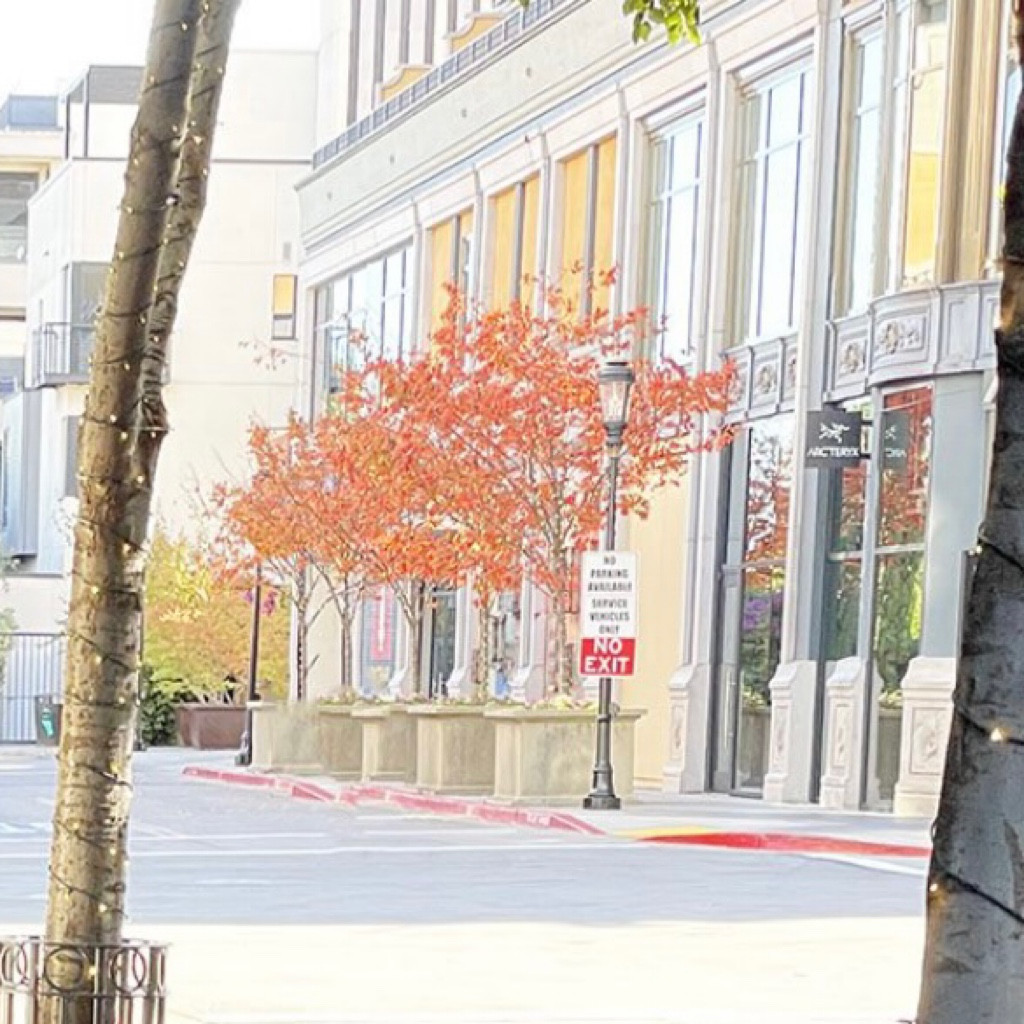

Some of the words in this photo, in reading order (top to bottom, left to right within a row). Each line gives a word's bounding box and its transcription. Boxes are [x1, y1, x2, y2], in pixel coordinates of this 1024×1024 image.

[603, 555, 617, 565] NO
[590, 569, 629, 578] PARKING
[588, 582, 633, 592] AVAILABLE
[591, 599, 628, 608] SERVICE
[589, 612, 630, 621] VEHICLES
[598, 625, 620, 634] ONLY
[593, 638, 623, 654] NO
[584, 656, 630, 673] EXIT
